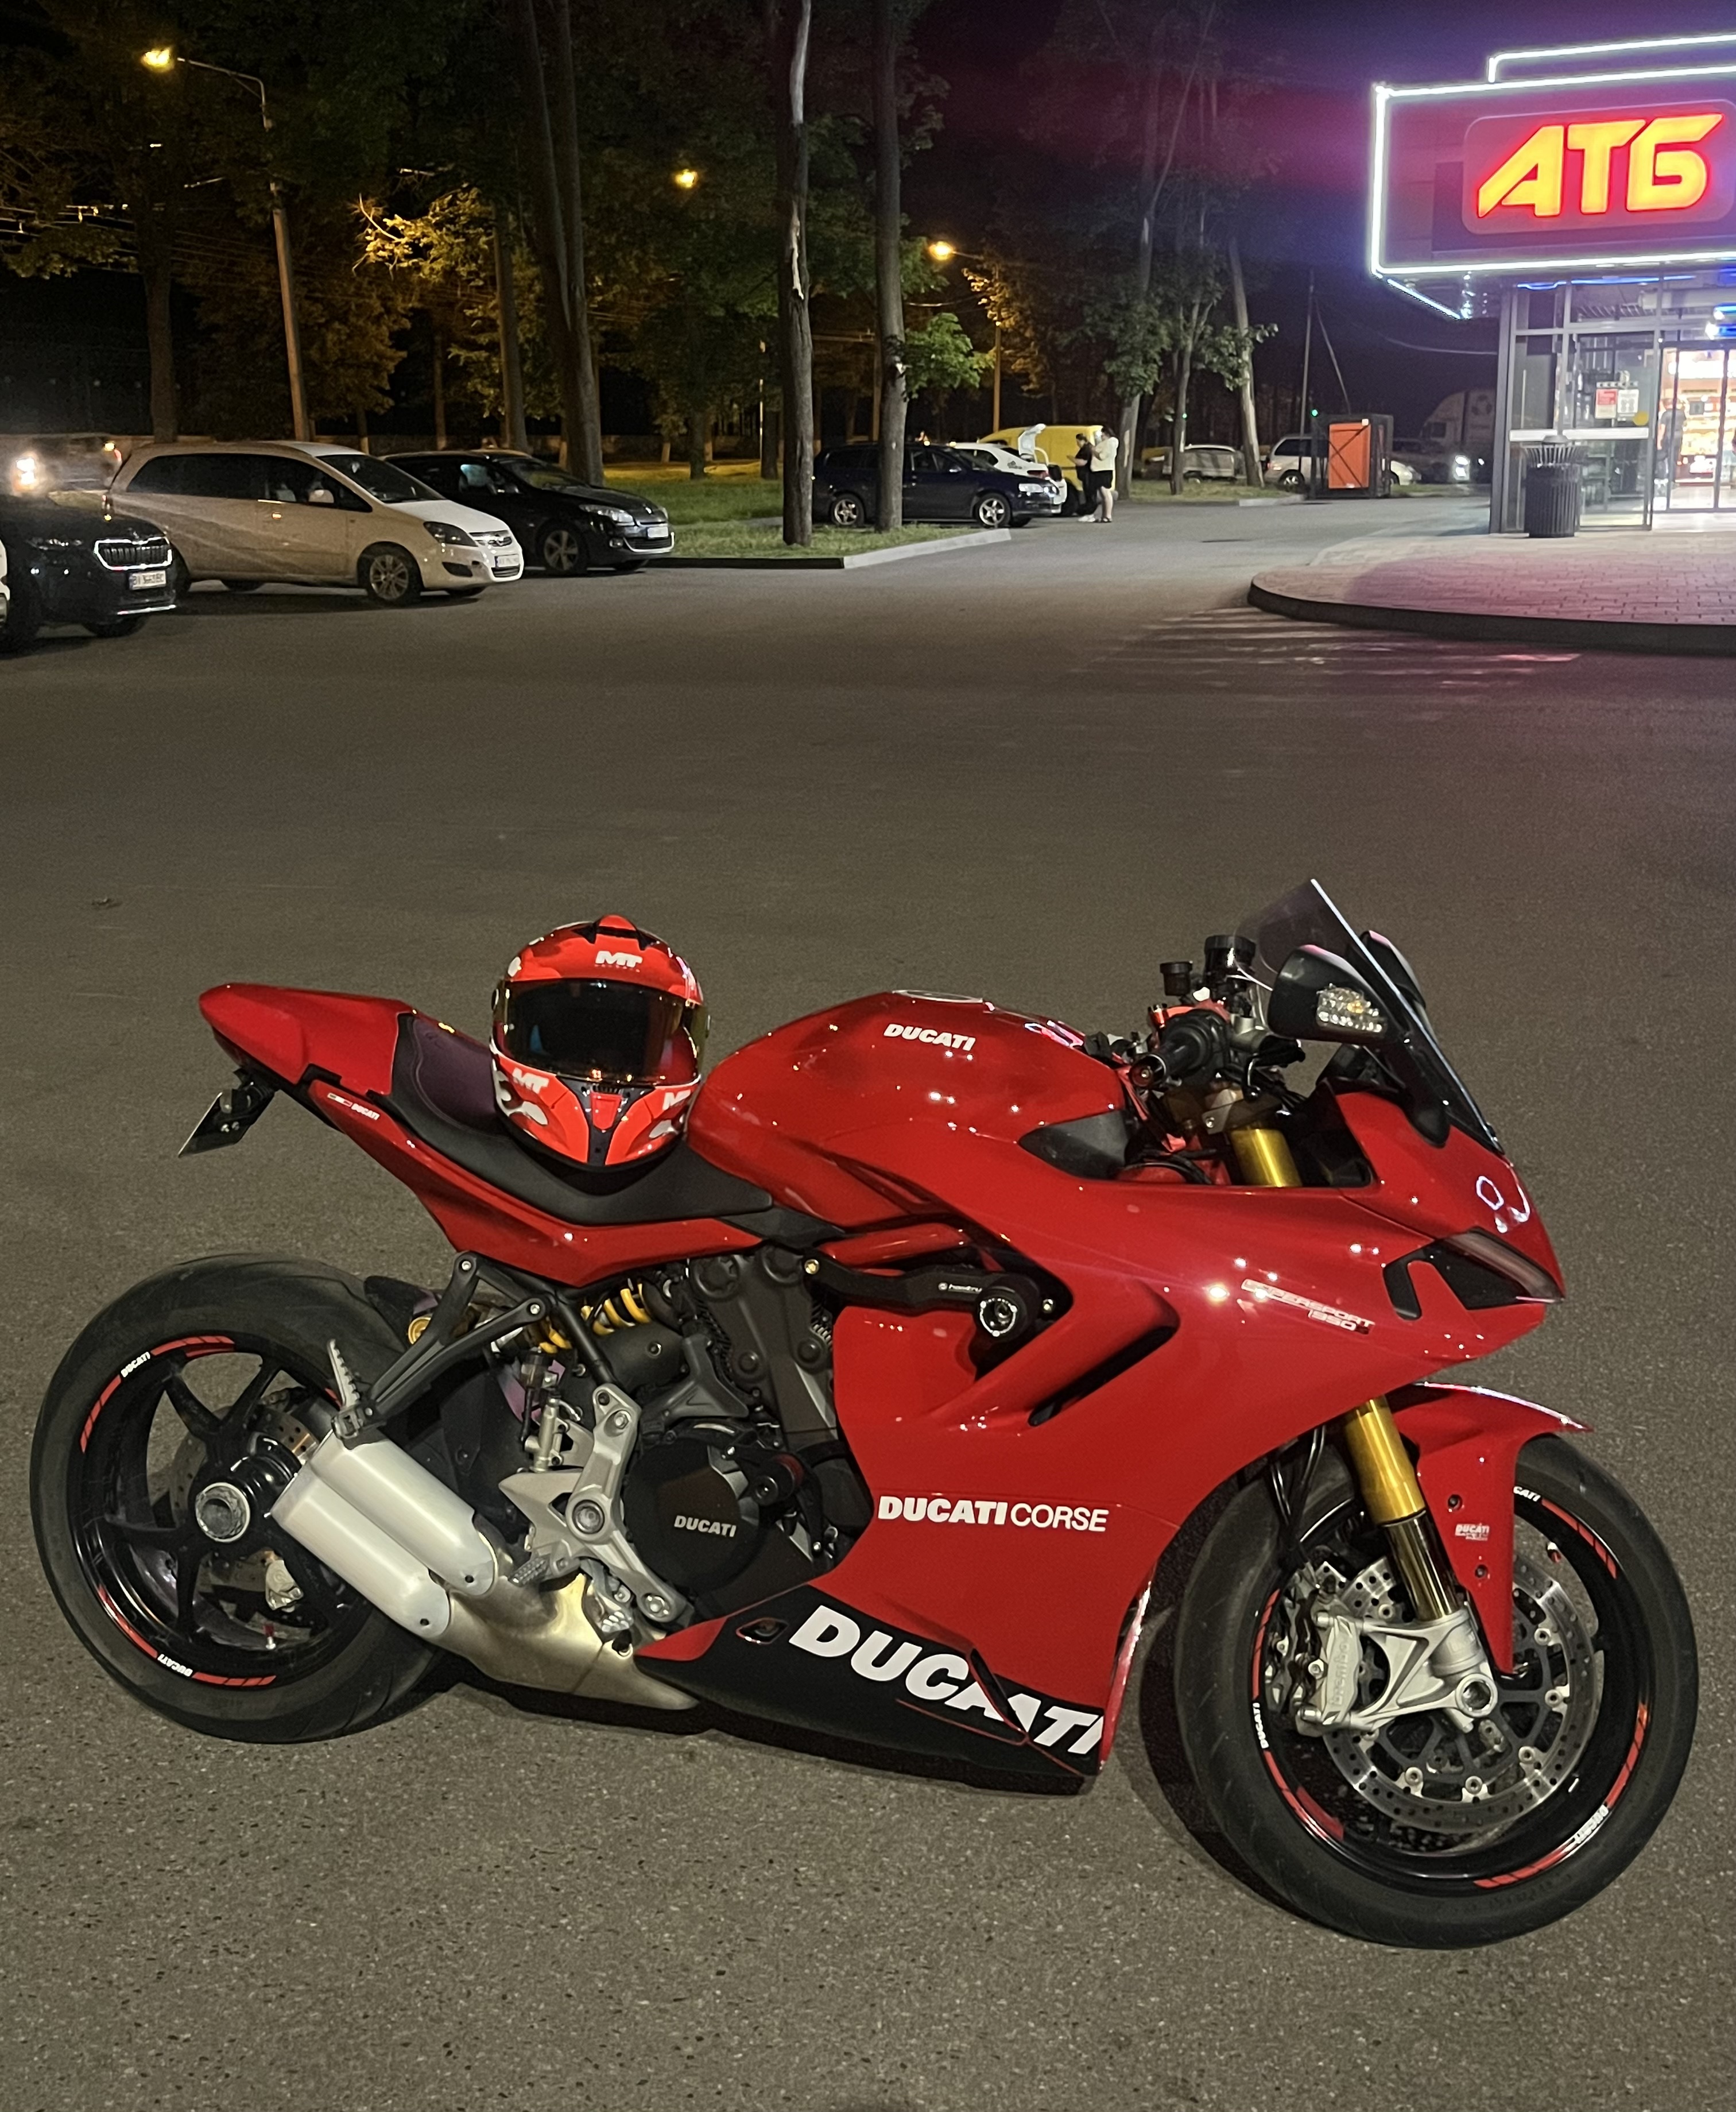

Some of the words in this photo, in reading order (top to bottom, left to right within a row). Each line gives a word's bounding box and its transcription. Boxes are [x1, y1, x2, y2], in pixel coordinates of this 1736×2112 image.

[1478, 114, 1723, 217] АТБ
[595, 950, 642, 968] MT
[884, 1023, 976, 1051] DUCATI
[512, 1067, 549, 1094] MT
[1242, 1279, 1375, 1328] SPERSPORT
[121, 1351, 151, 1378] DUCATI
[674, 1515, 737, 1537] DUCATI
[878, 1496, 1008, 1525] DUCATI
[1010, 1503, 1109, 1532] CORSE
[157, 1654, 193, 1677] DUCATI
[788, 1605, 1104, 1754] DUCATI
[1328, 1642, 1350, 1705] brembo
[1252, 1702, 1269, 1749] DUCATI
